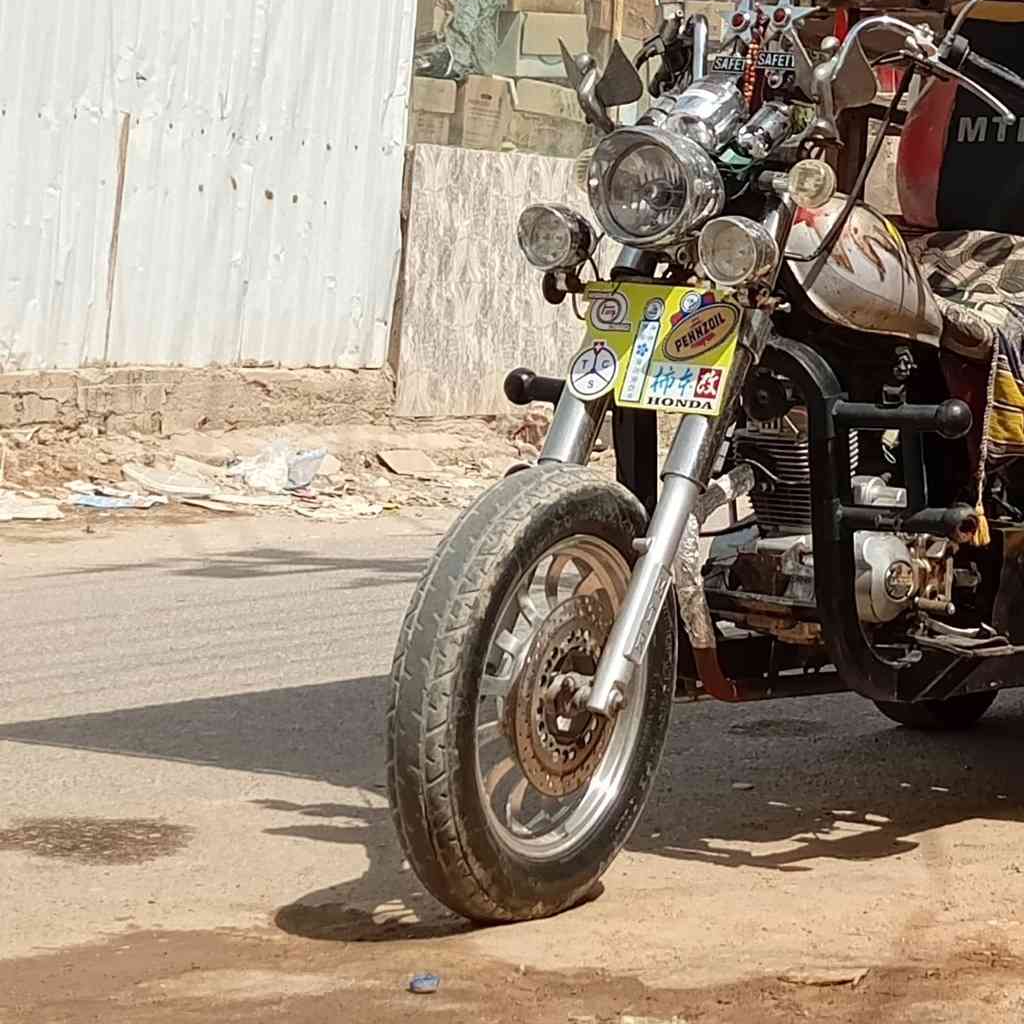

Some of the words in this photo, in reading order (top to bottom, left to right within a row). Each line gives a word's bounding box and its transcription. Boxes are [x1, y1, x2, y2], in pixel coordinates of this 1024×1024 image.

[714, 57, 746, 71] SAFET
[674, 313, 726, 353] PENNZOIL
[647, 396, 713, 410] HONDA
